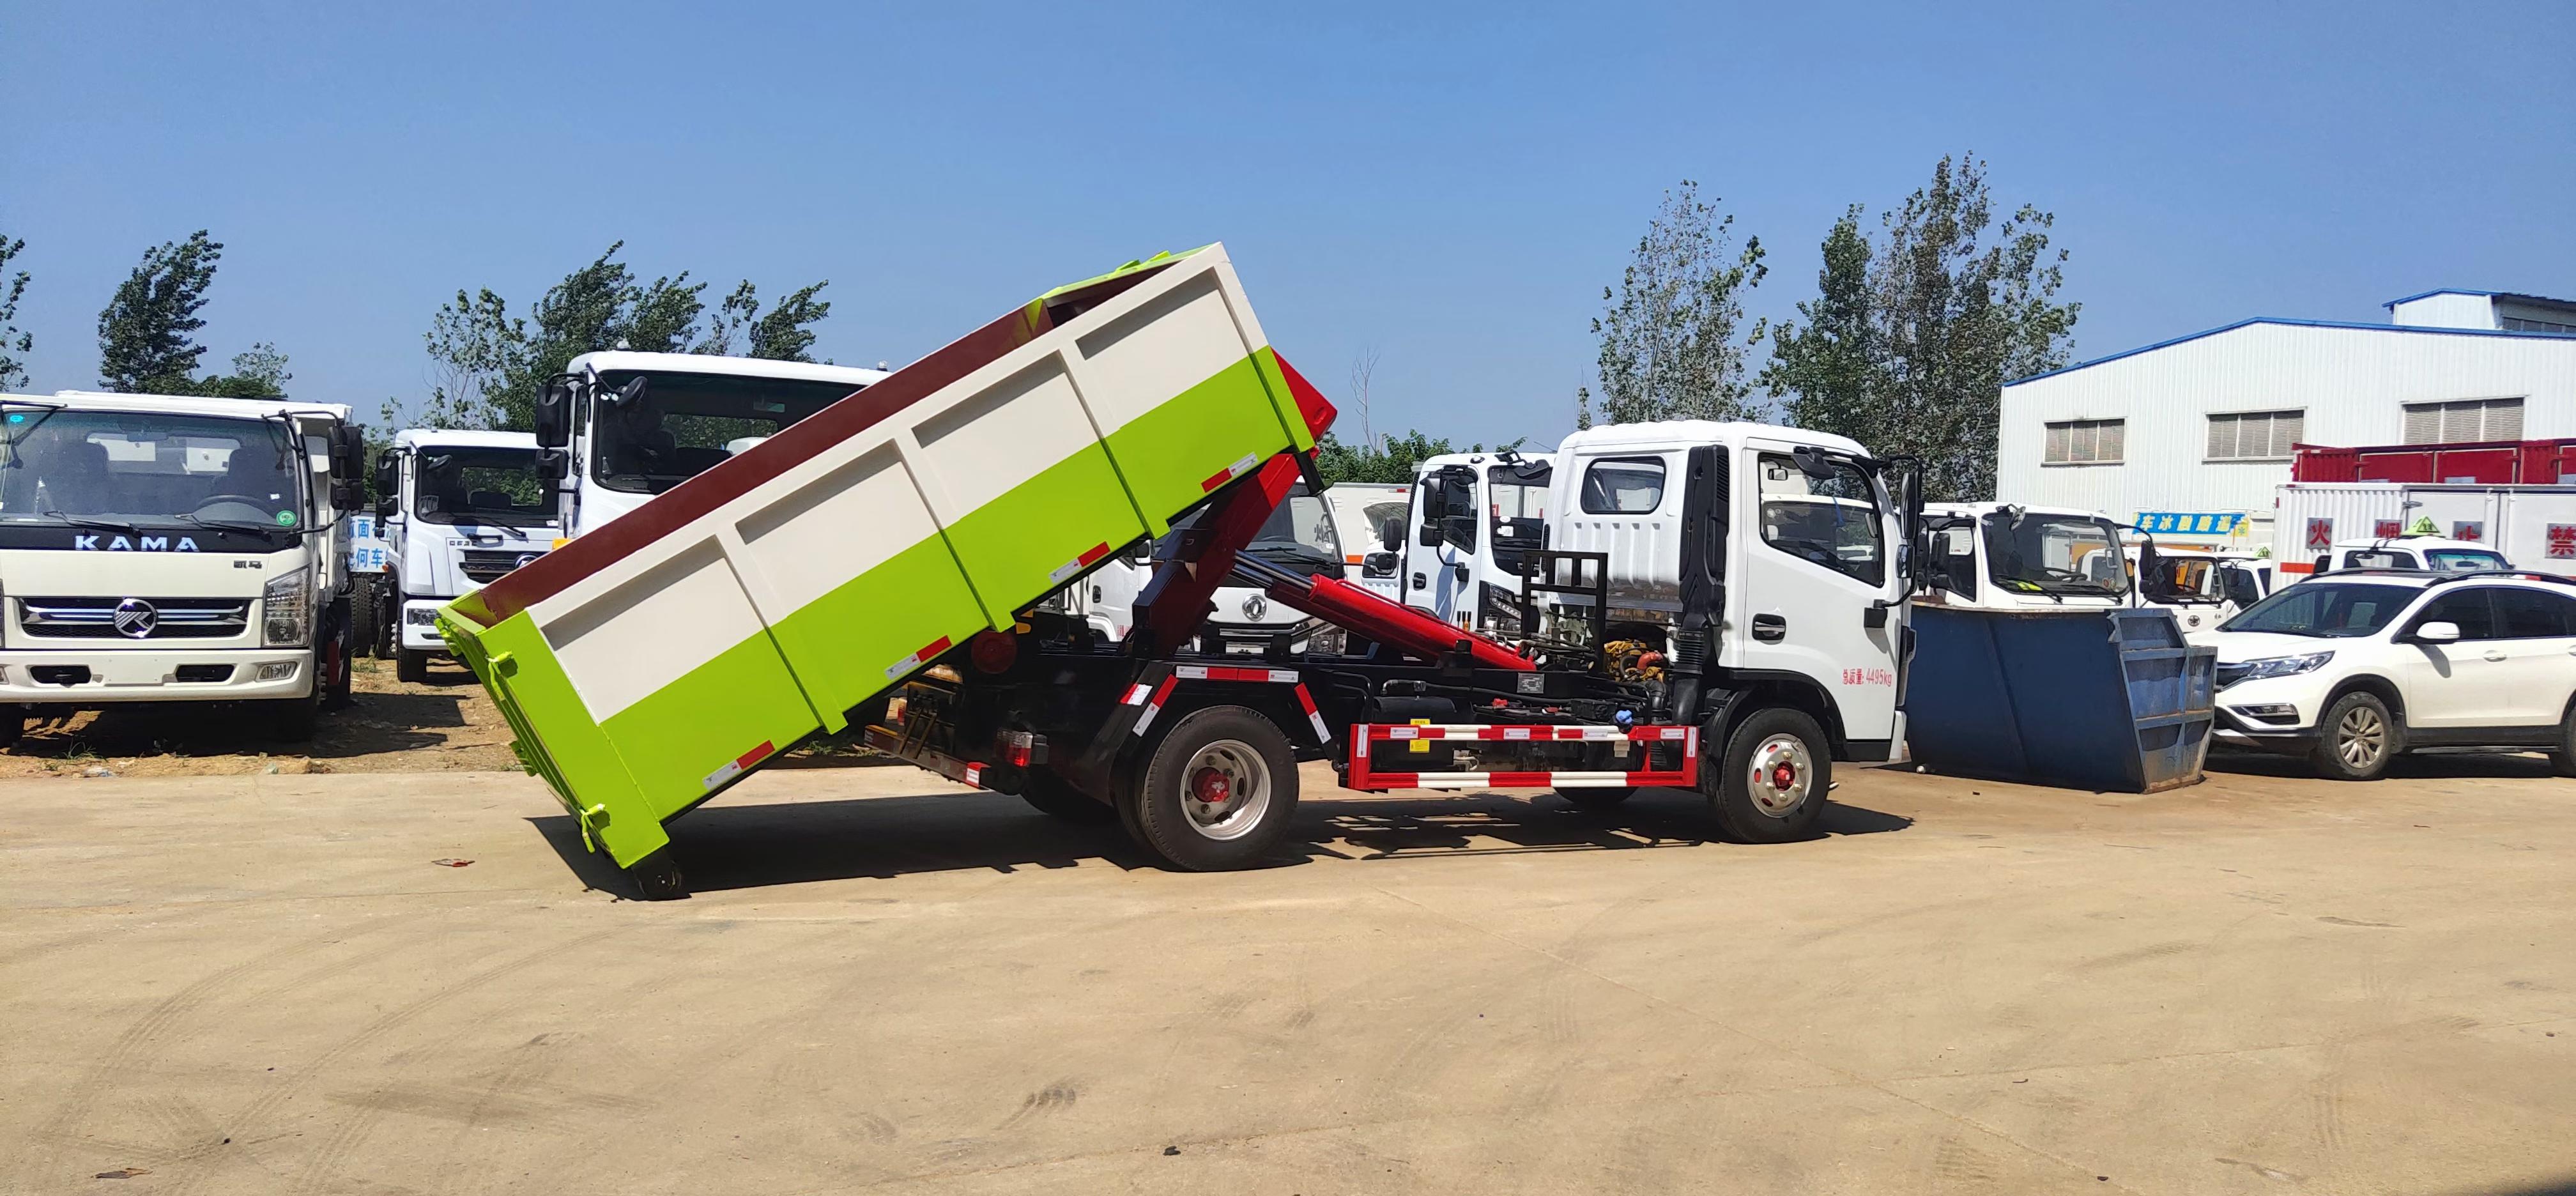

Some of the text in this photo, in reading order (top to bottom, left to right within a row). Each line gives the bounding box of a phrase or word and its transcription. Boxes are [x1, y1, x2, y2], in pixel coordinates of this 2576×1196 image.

[2310, 520, 2330, 546] 火
[75, 535, 200, 552] KAMA
[1866, 667, 1892, 687] 4495kg
